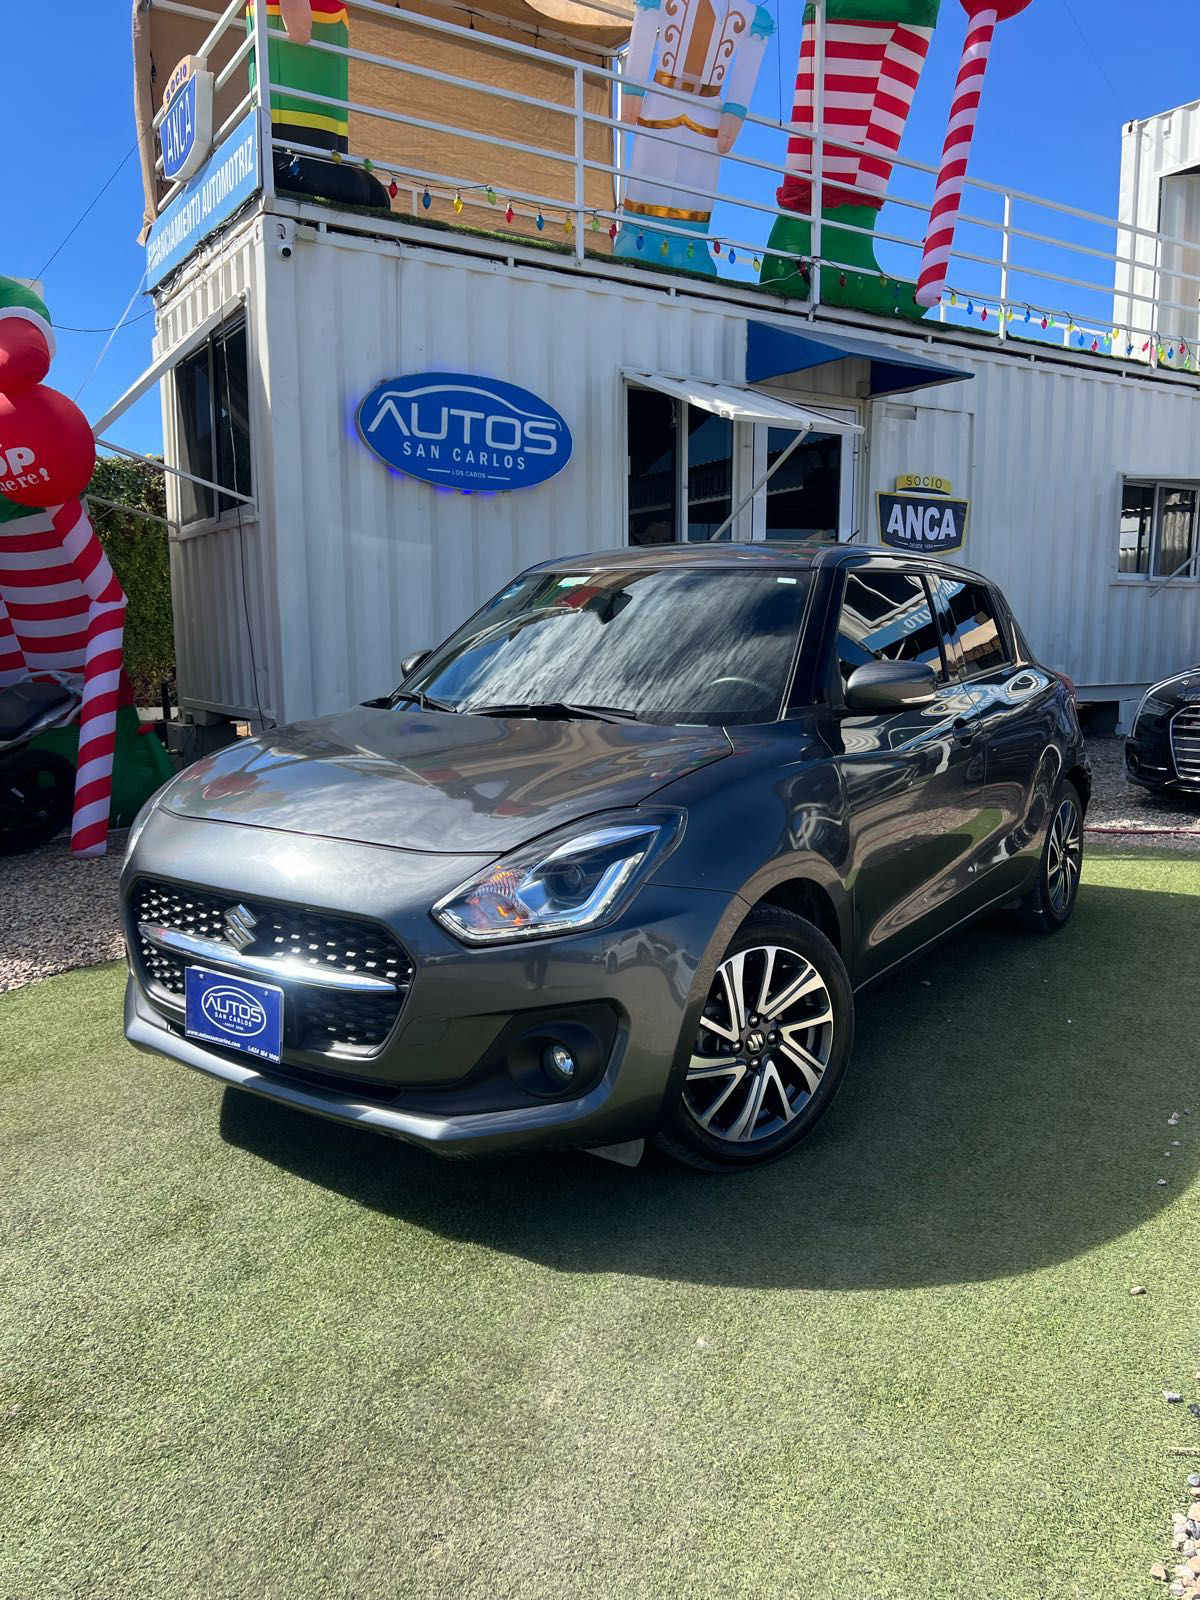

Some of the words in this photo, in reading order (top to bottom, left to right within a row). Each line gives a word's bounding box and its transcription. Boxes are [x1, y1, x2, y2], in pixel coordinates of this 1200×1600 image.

[166, 64, 188, 103] SOCIO
[167, 91, 192, 164] ANCA
[202, 135, 254, 220] AUTOMOTRIZ
[367, 399, 558, 456] AUTOS
[403, 441, 440, 459] SAN
[452, 448, 526, 470] CARLOS
[906, 475, 943, 489] SOCIO
[886, 503, 957, 540] ANCA
[205, 995, 262, 1023] AUTOS
[214, 1011, 227, 1020] SAN
[229, 1015, 252, 1027] CARLOS
